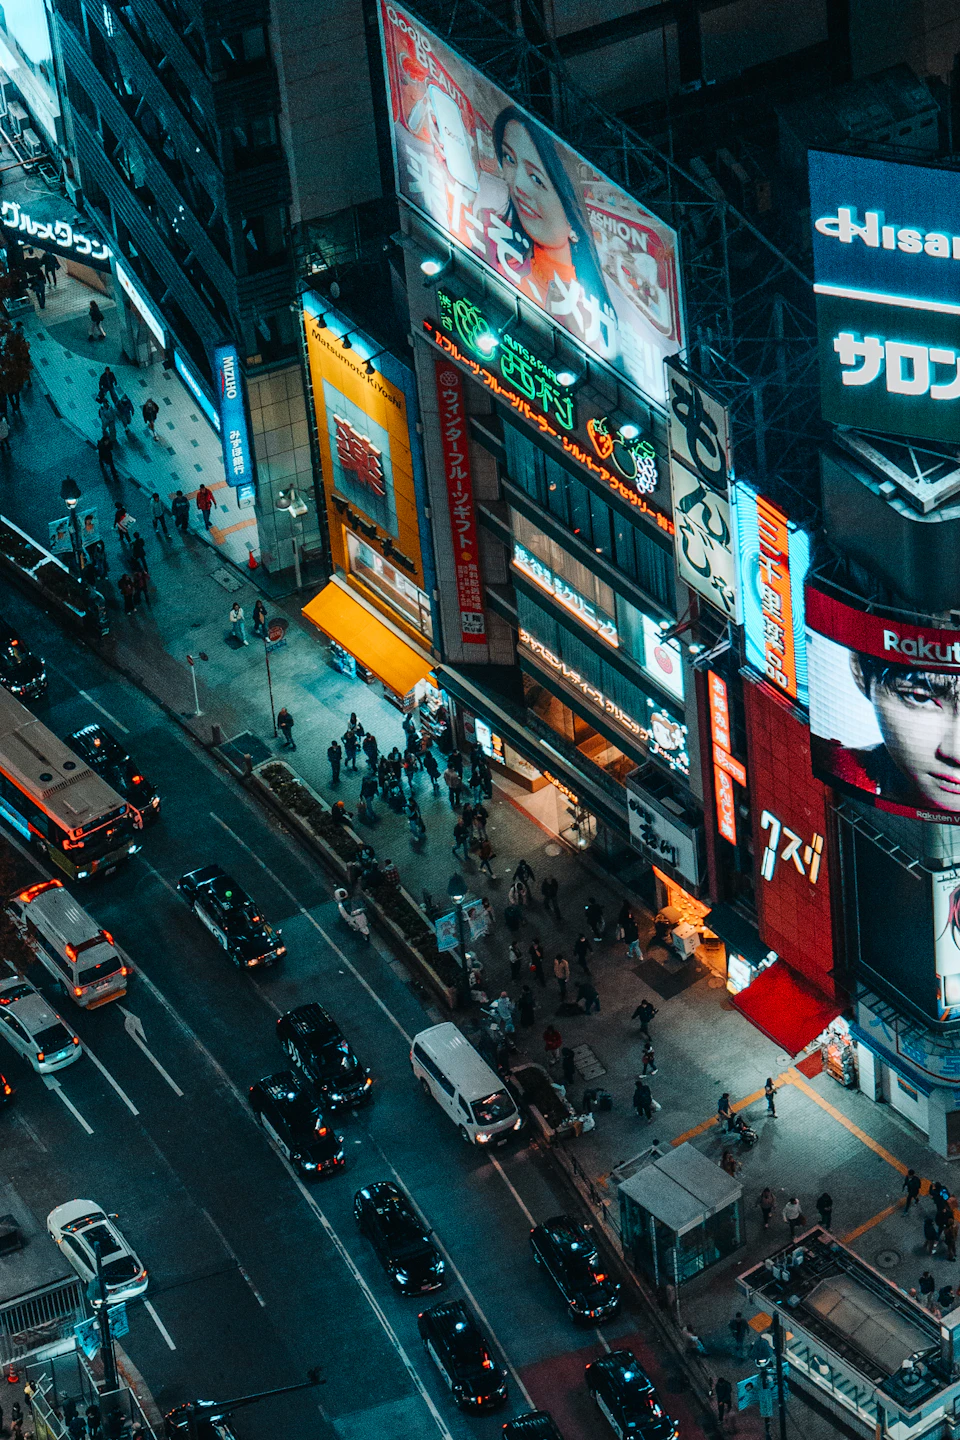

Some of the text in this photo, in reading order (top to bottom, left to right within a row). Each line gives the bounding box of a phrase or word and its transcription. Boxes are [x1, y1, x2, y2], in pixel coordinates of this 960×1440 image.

[386, 6, 432, 52] Qoo10
[0, 200, 113, 260] グルメタウン
[221, 355, 239, 400] MIZUHO
[310, 327, 367, 379] Matsumoto
[229, 430, 245, 475] みずほ銀行
[332, 412, 387, 497] 薬
[441, 389, 473, 549] ウィンターフルーツギフト
[756, 511, 790, 689] 三千里薬品
[915, 810, 951, 822] Rakuten
